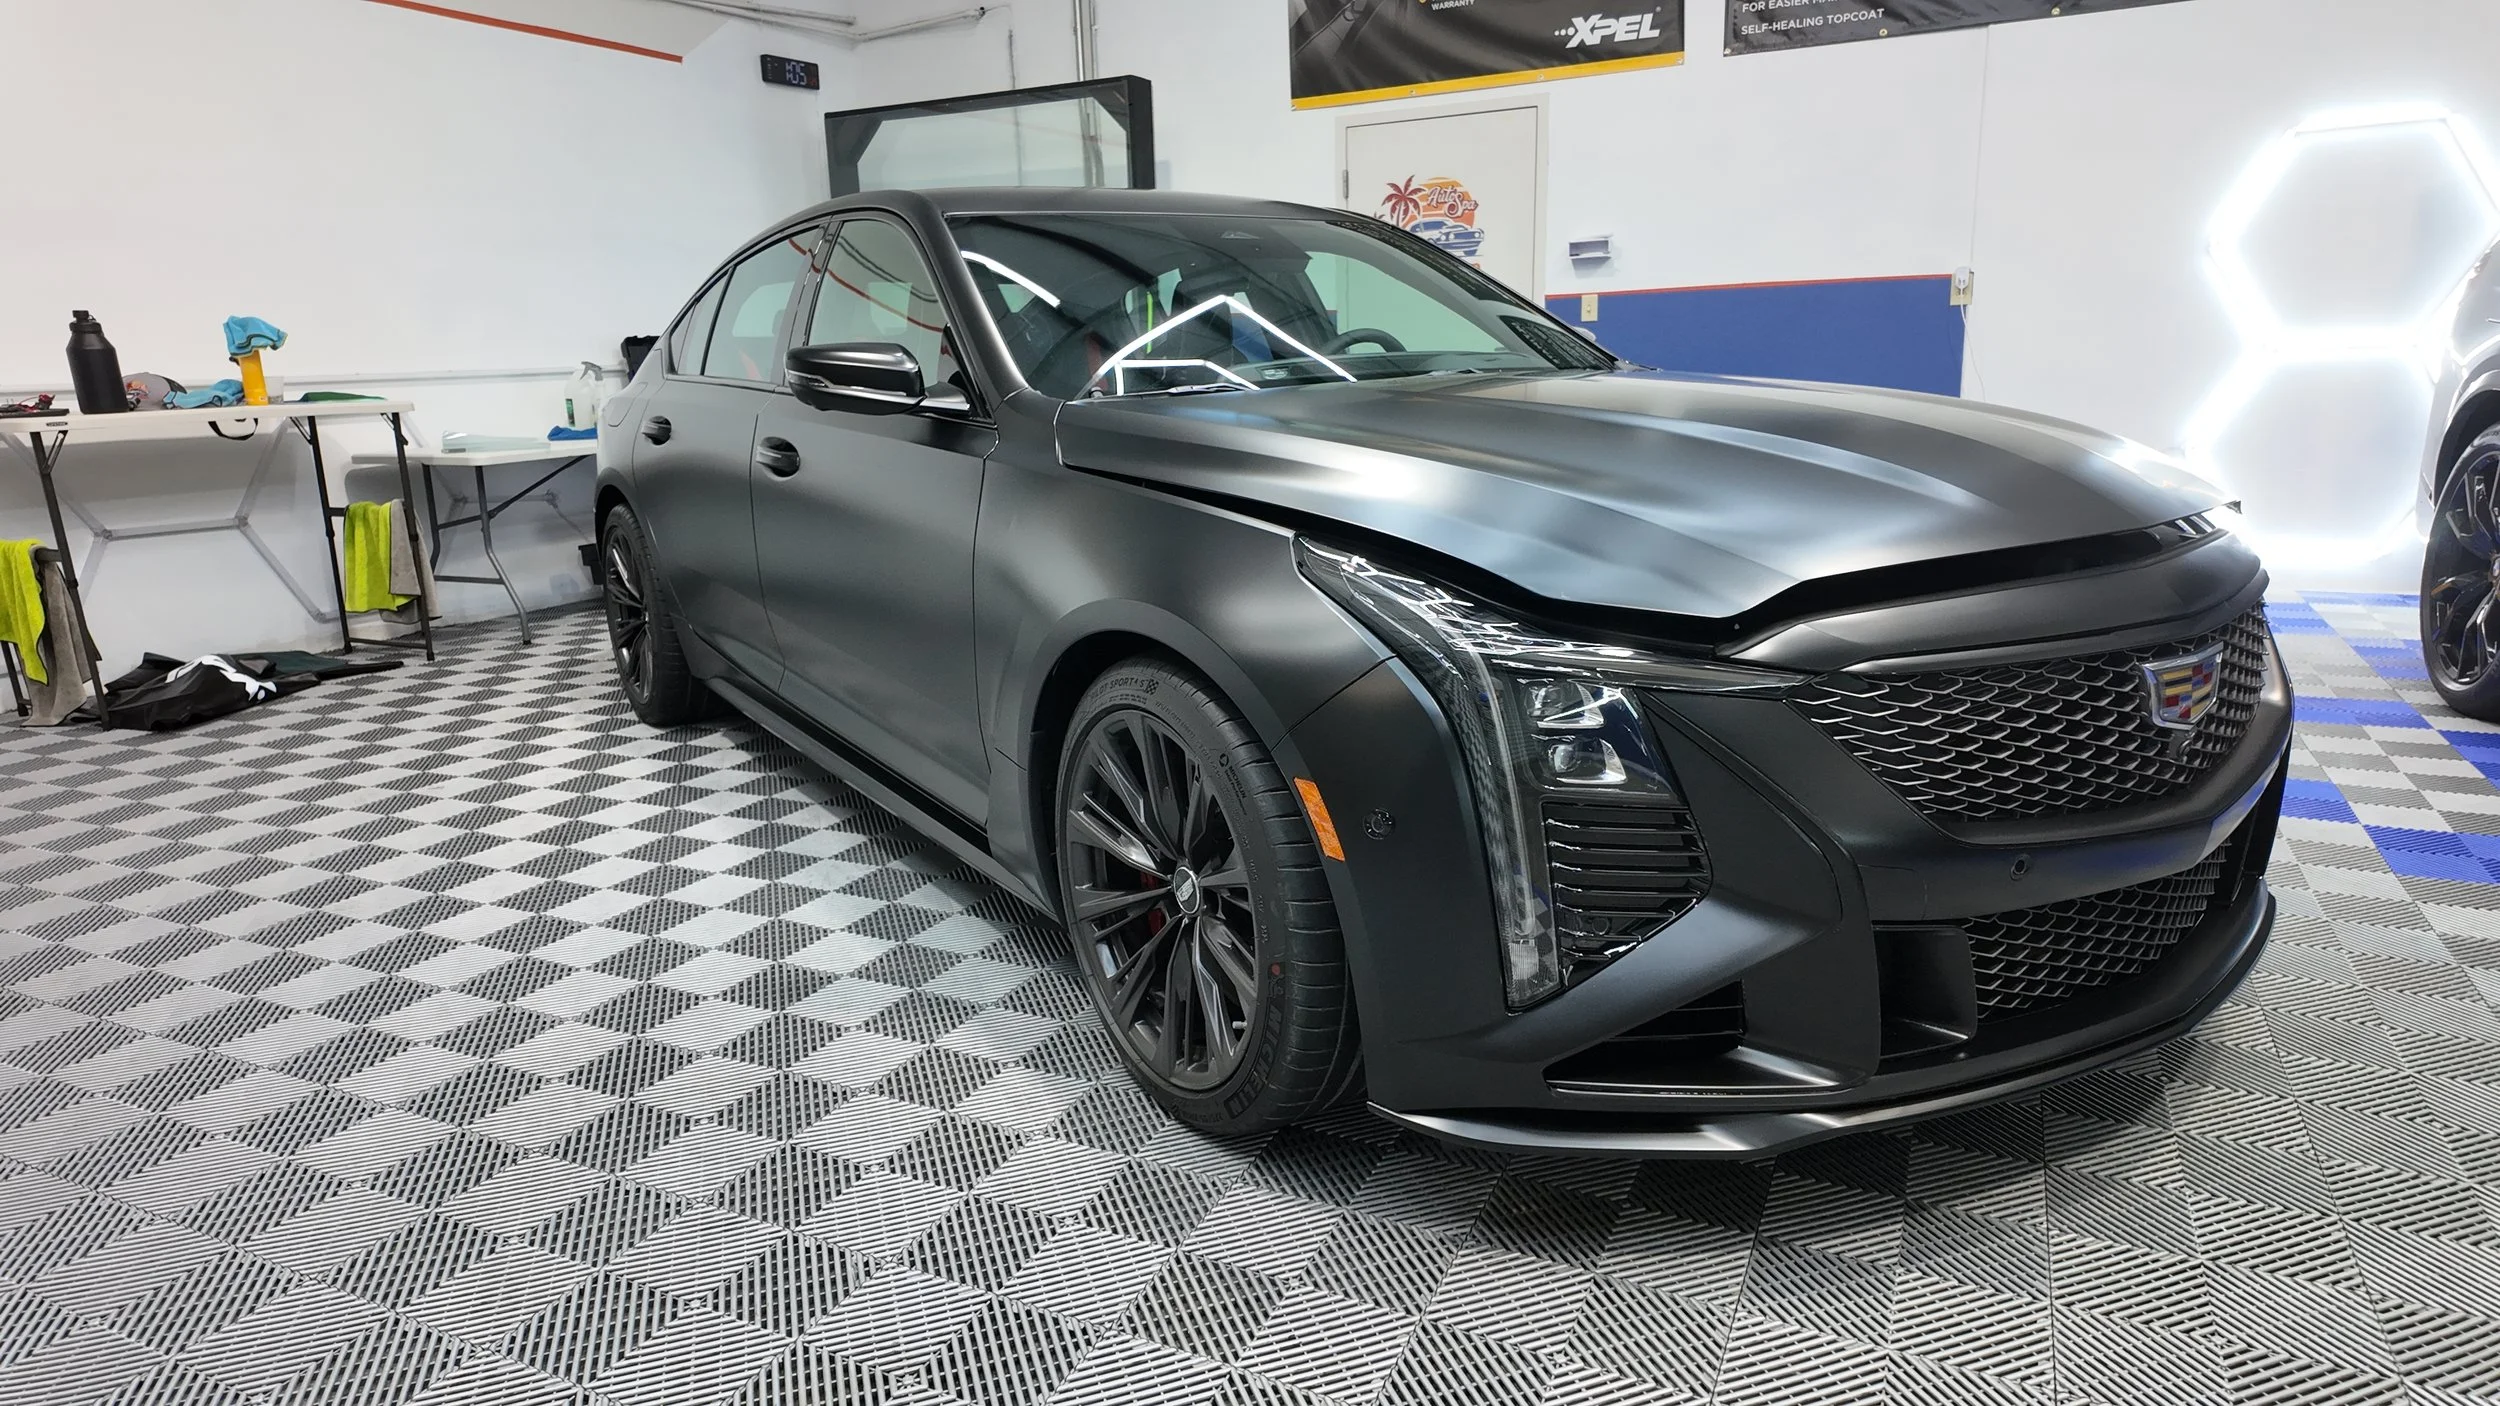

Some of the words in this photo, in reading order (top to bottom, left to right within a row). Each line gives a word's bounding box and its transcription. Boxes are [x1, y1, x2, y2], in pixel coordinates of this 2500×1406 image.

[1431, 0, 1475, 11] WARRANTY
[1742, 2, 1766, 13] FOR
[1768, 0, 1809, 9] EASIER
[1565, 13, 1661, 49] XPEL
[1741, 16, 1824, 35] SELF-HEALING
[1827, 8, 1885, 25] TOPCOAT
[1427, 186, 1457, 208] Auto
[1444, 192, 1479, 218] Spa
[1109, 677, 1134, 689] SPORT
[1227, 1003, 1283, 1117] MICHELIN
